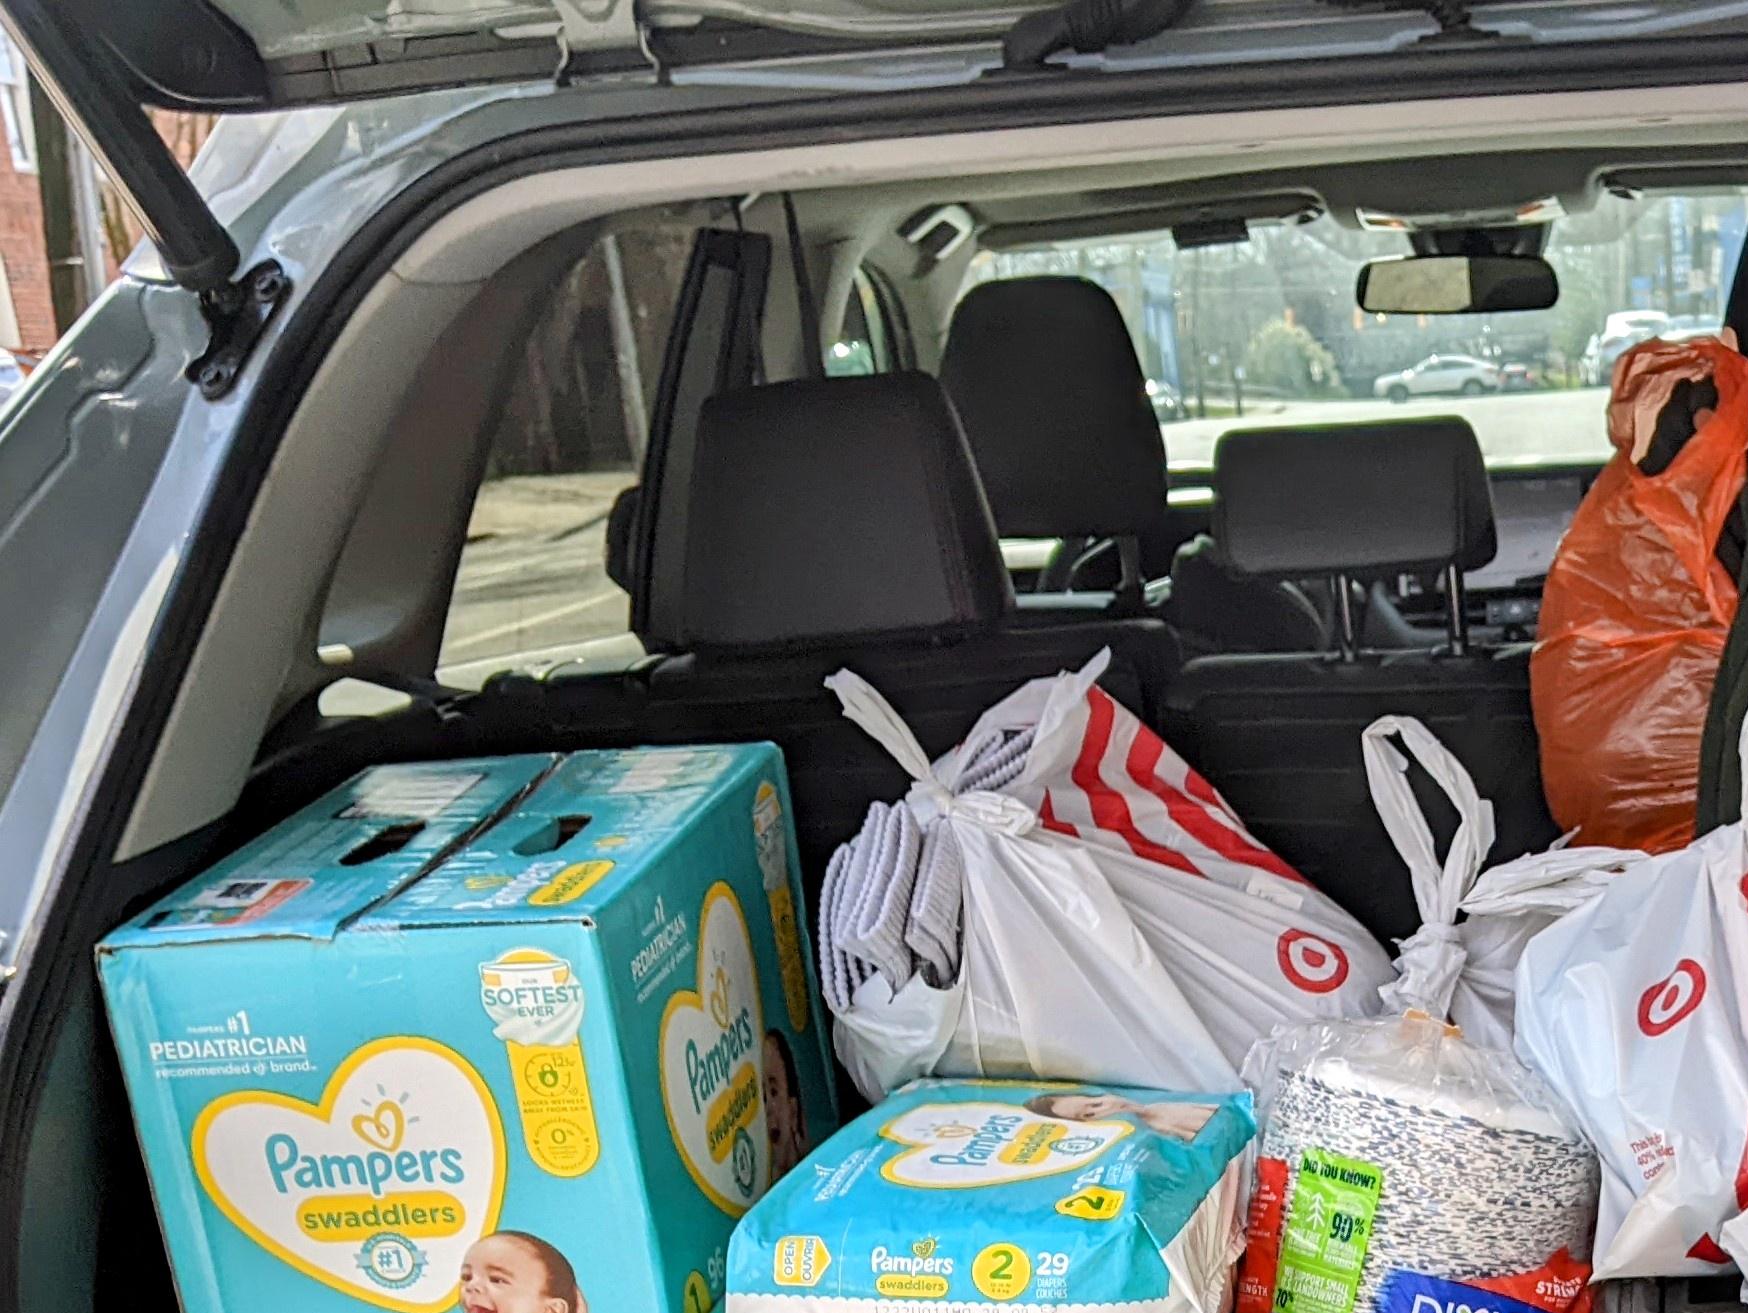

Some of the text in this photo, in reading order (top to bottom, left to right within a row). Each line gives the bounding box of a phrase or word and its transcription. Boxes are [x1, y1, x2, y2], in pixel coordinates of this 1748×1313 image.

[484, 985, 581, 1006] SOFTEST
[227, 1010, 250, 1035] #1
[517, 1006, 555, 1017] EVER
[150, 1036, 307, 1061] PEDIATRICIAN
[685, 1006, 755, 1114] Pampers
[156, 1062, 250, 1079] recommended
[709, 1072, 758, 1151] swaddlers
[929, 1114, 1024, 1167] Pampers
[264, 1133, 465, 1196] Pampers
[1303, 1158, 1376, 1190] DID YOU KNOW?
[303, 1202, 457, 1230] swaddlers
[1064, 1195, 1105, 1211] 2
[376, 1249, 406, 1270] #1
[783, 1240, 796, 1277] OPEN
[802, 1239, 815, 1282] OUVRIR
[871, 1246, 954, 1276] Pampers
[989, 1249, 1013, 1280] 2
[1035, 1252, 1069, 1276] 29
[879, 1279, 945, 1293] swaddlers
[1036, 1277, 1067, 1289] DIAPERS
